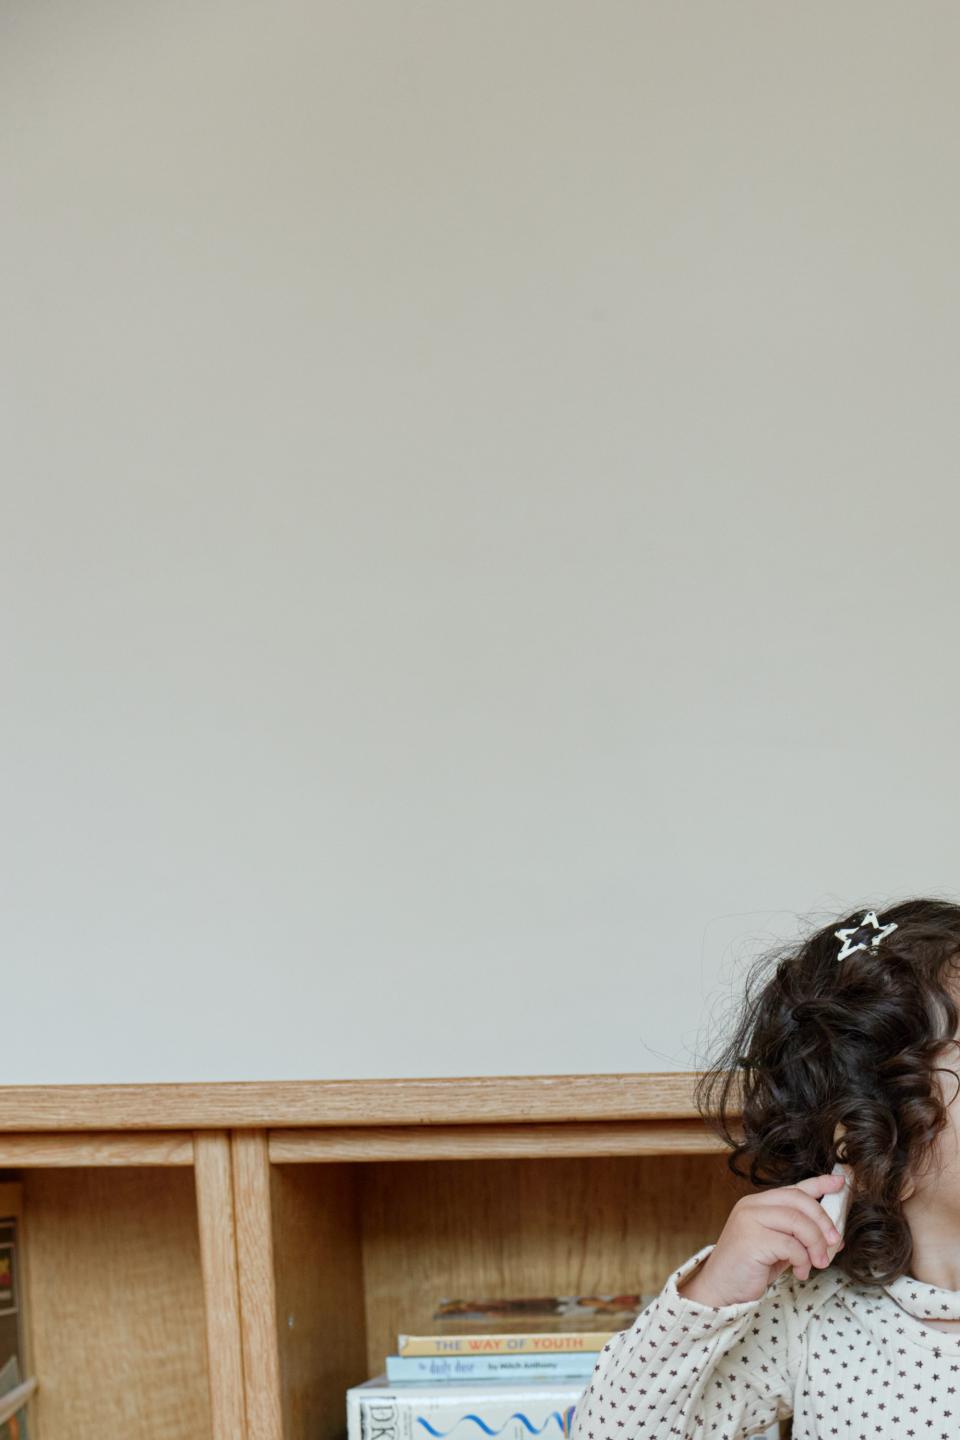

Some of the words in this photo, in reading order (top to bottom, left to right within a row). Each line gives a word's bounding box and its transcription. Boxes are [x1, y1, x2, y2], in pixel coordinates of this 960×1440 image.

[435, 1341, 462, 1351] THE
[468, 1340, 500, 1351] WAY
[506, 1339, 526, 1350] OF
[532, 1338, 584, 1349] YOUTH
